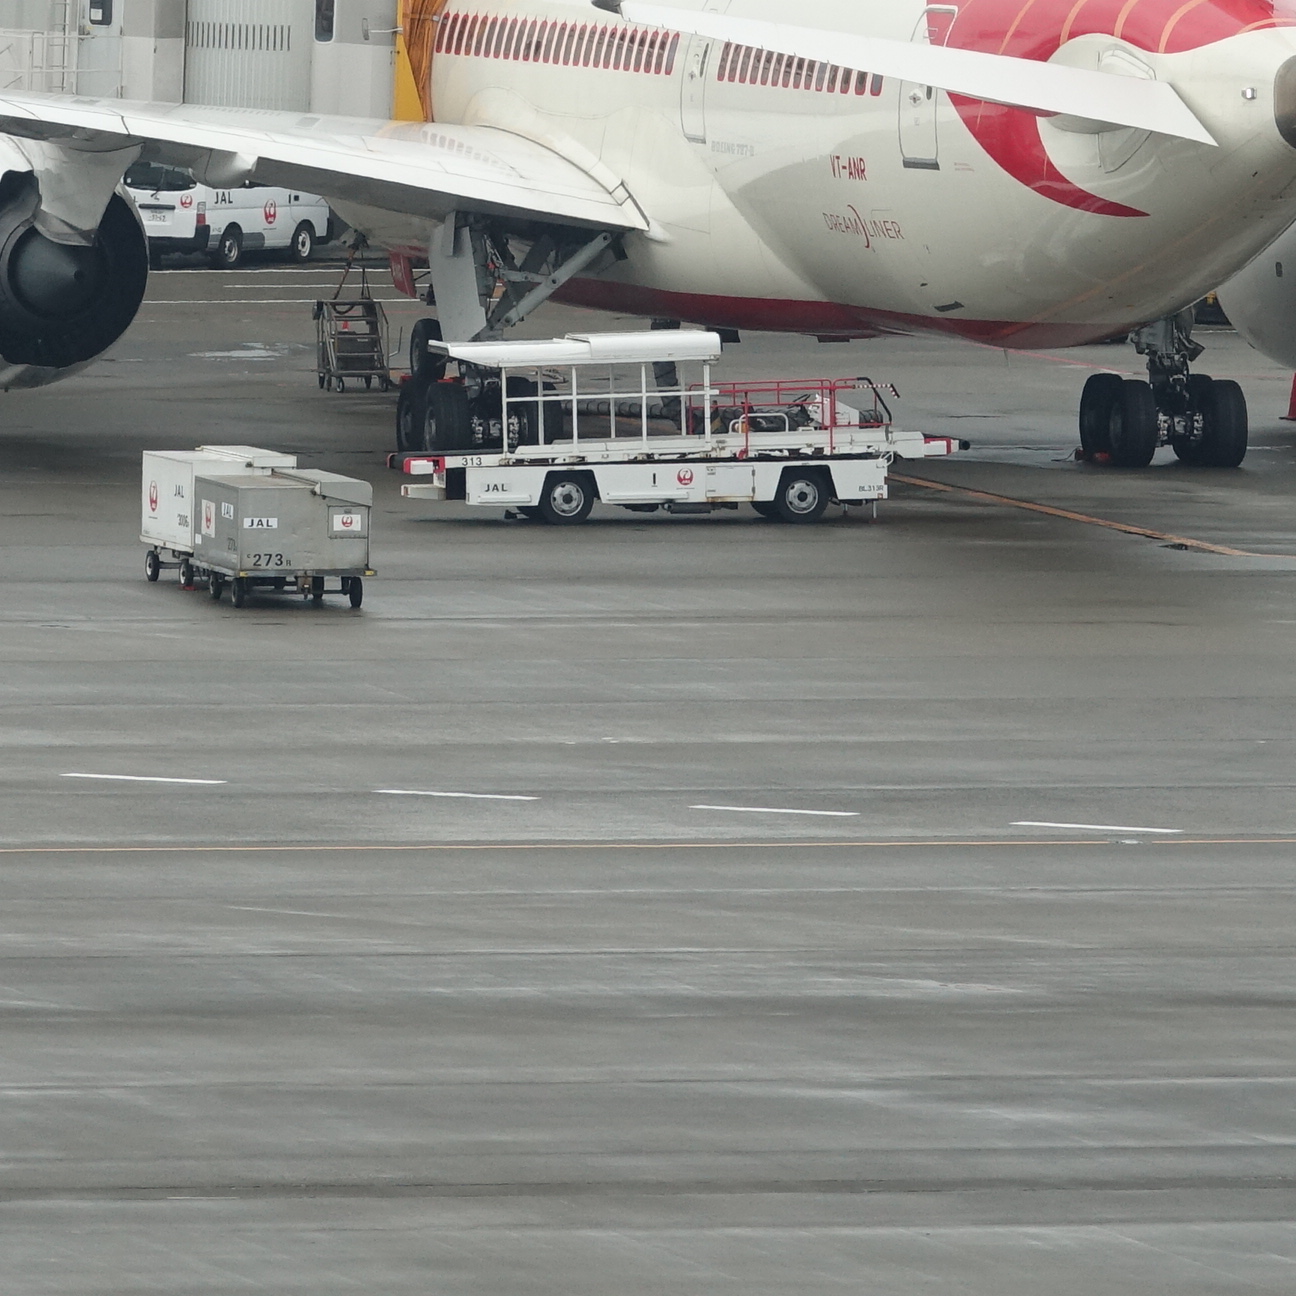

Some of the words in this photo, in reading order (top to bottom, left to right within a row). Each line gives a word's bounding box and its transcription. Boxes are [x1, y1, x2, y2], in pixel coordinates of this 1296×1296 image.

[829, 154, 867, 181] VT-ANR
[214, 191, 233, 204] JAL
[461, 457, 483, 467] 313
[484, 483, 508, 492] JAL
[248, 518, 273, 528] JAL
[253, 554, 284, 566] 273
